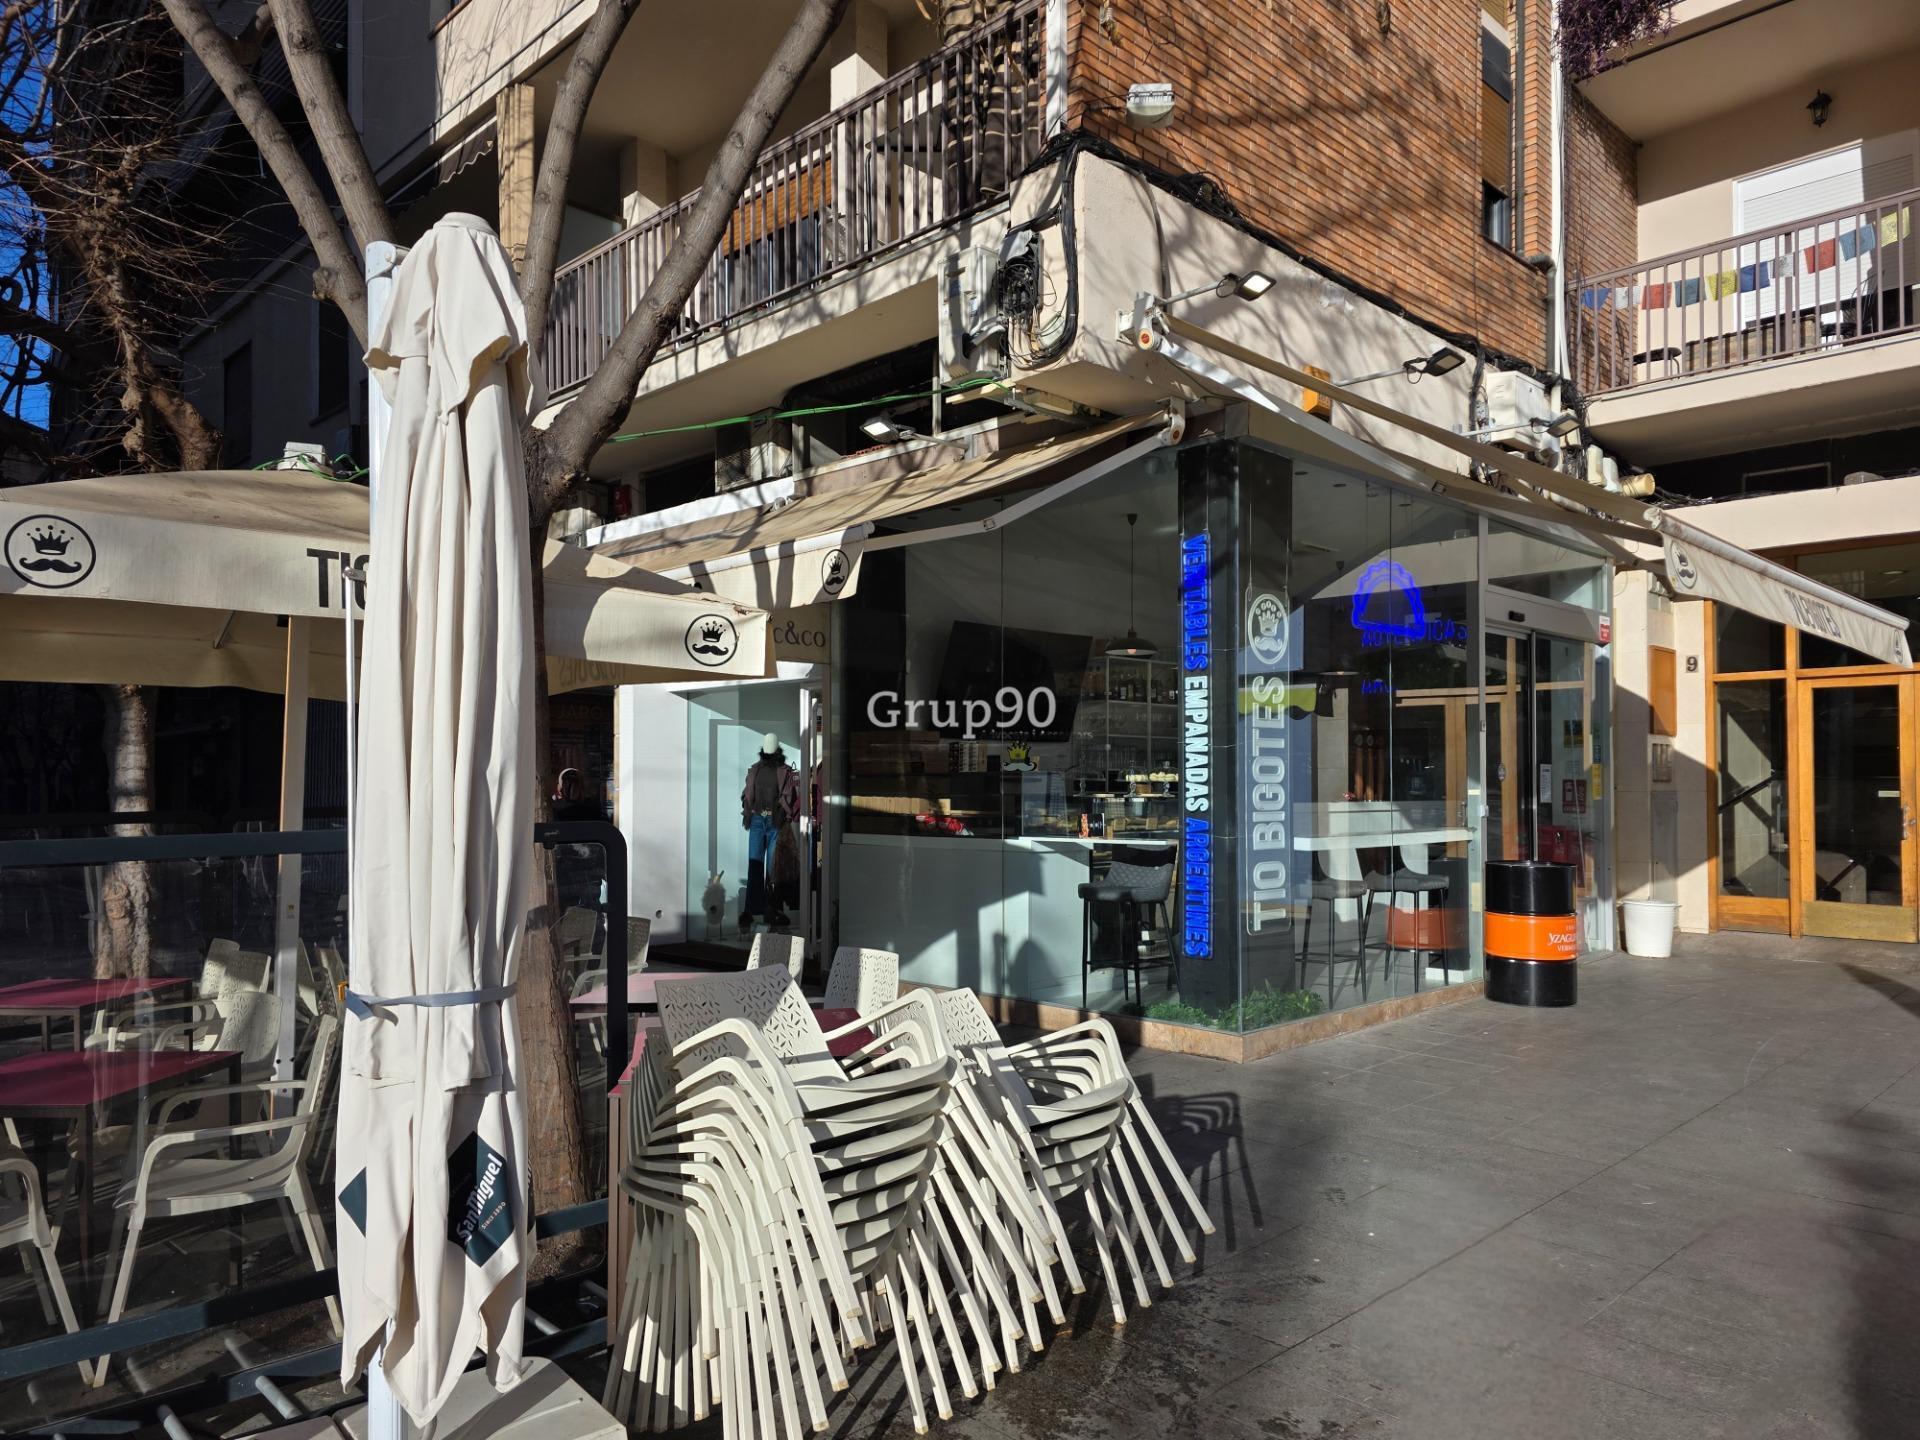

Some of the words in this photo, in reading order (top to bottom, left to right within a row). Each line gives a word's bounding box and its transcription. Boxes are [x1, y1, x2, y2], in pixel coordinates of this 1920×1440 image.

[1687, 656, 1698, 671] 9
[1184, 675, 1209, 812] EMPANADAS
[1252, 675, 1286, 851] BIGOTES
[1184, 817, 1210, 958] ARGENTINES
[1253, 860, 1287, 931] TIO
